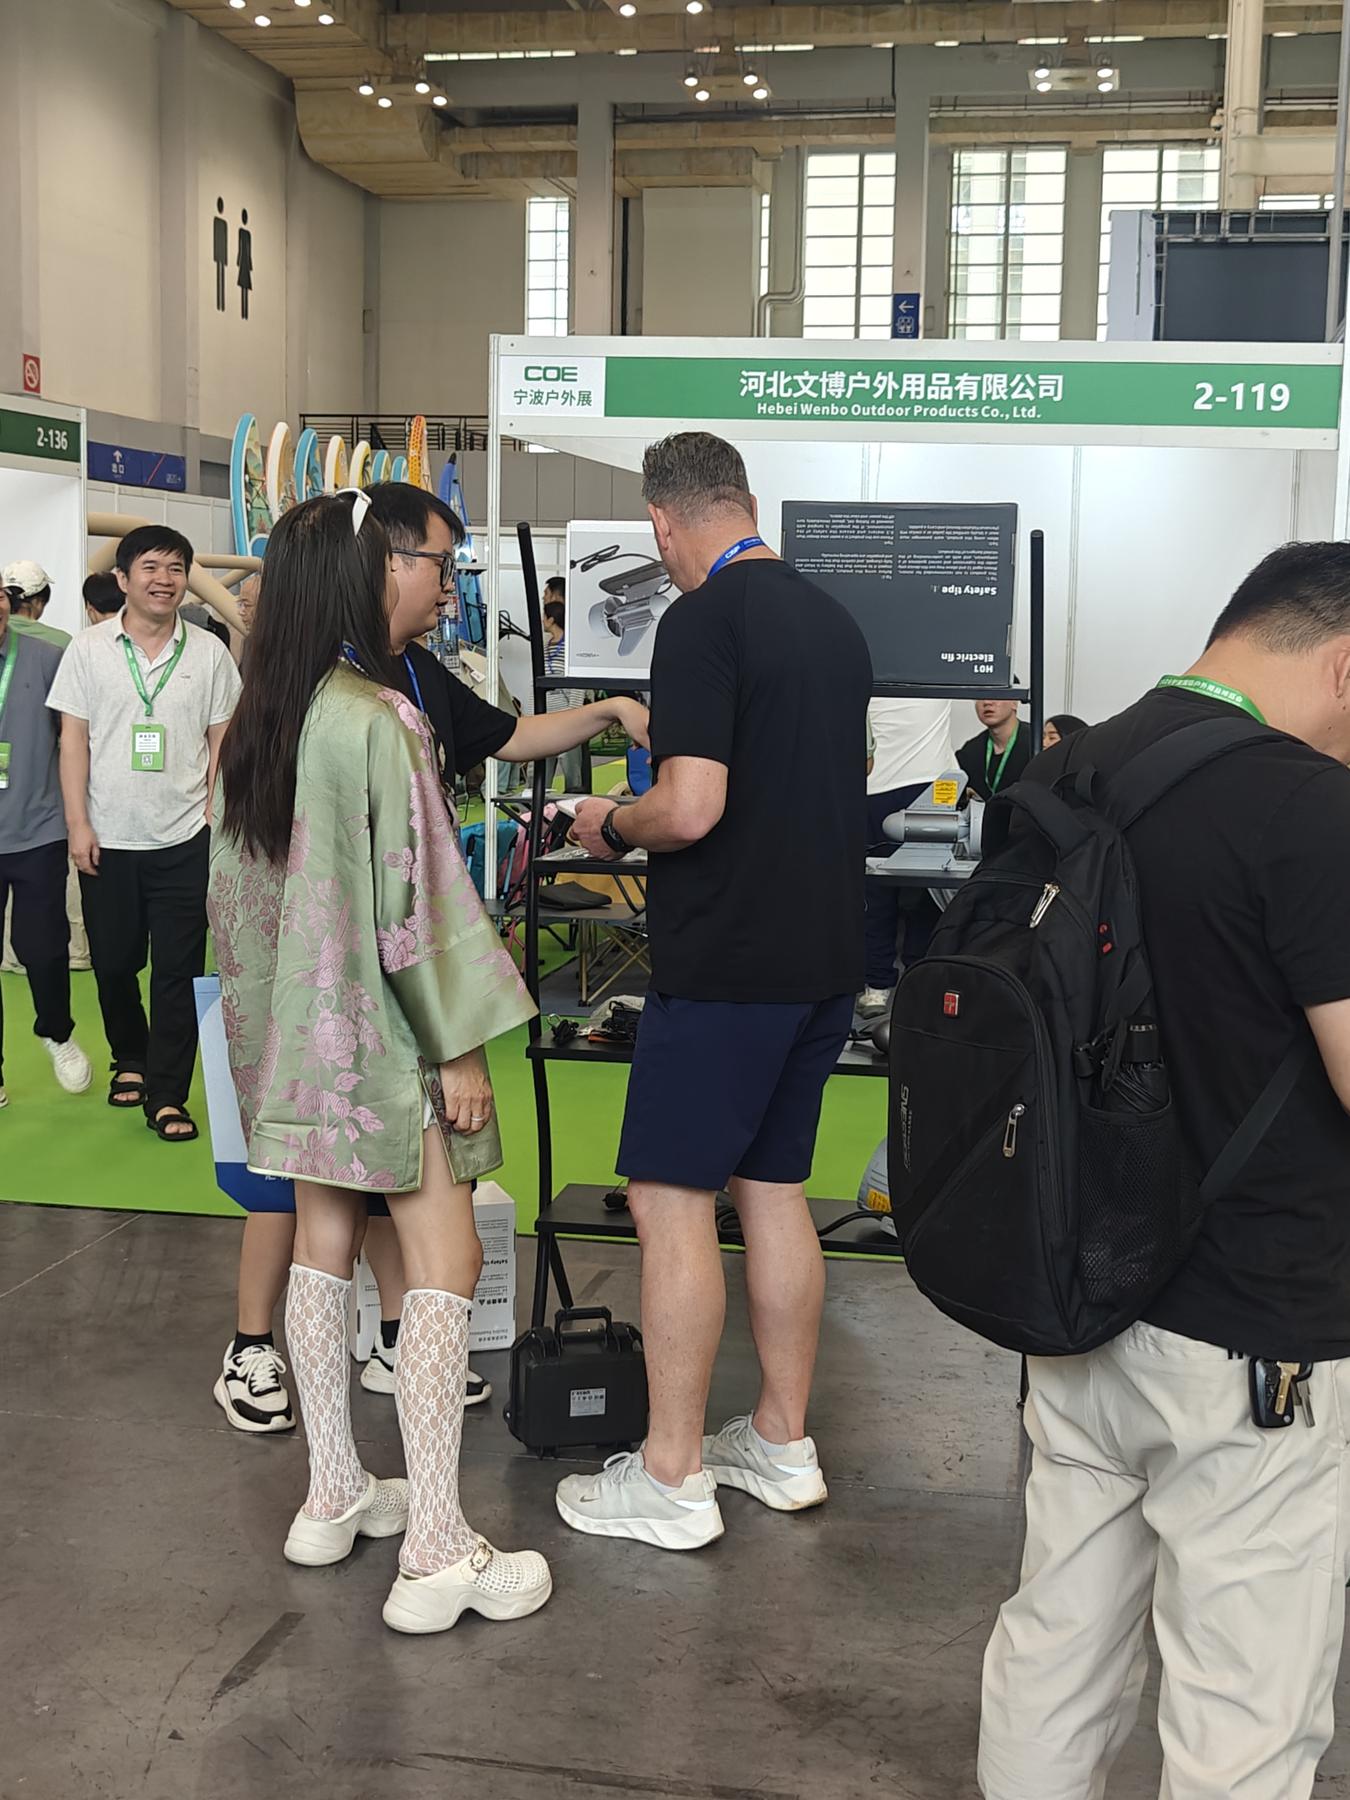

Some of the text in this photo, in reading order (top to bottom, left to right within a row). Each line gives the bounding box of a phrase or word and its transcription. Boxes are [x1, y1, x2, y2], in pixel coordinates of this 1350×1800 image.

[524, 366, 578, 382] COE
[739, 370, 1064, 402] 河北文博户外用品有限公司
[513, 388, 593, 407] 宁波户外展
[1193, 382, 1290, 412] 2-119
[757, 402, 798, 415] Hebei
[800, 403, 849, 416] Wenbo
[851, 403, 911, 417] Outdoor
[913, 404, 979, 418] Products
[37, 427, 68, 450] 2-136
[963, 584, 997, 596] Safety
[941, 653, 994, 663] Electric fin
[974, 664, 993, 673] H01
